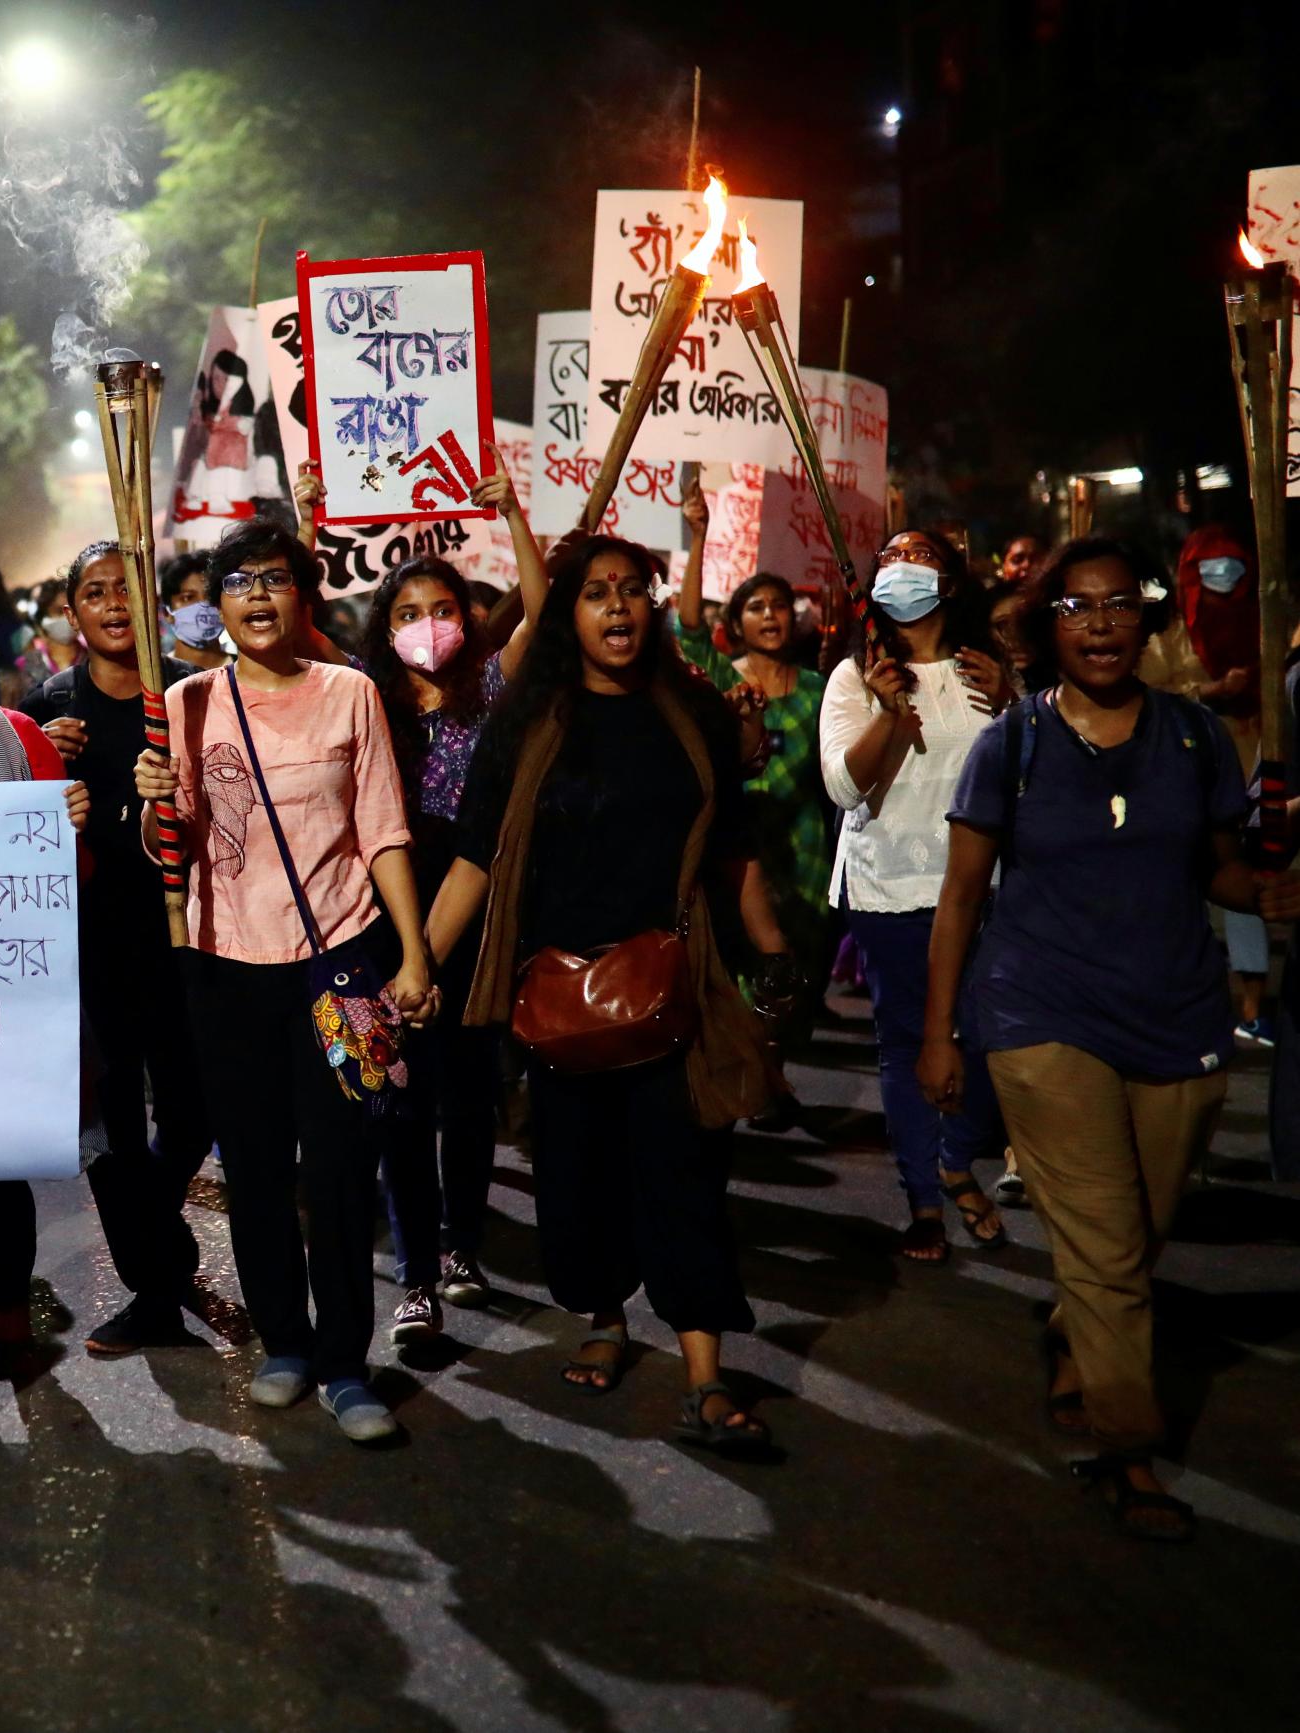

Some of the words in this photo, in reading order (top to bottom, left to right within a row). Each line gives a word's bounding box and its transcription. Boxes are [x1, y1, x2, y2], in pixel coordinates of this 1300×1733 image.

[321, 285, 403, 335] তোর
[353, 328, 473, 392] বাপের
[330, 392, 429, 462] রাস্তা
[600, 379, 679, 416] বার
[690, 370, 782, 425] অধিকার
[398, 429, 479, 511] না
[5, 811, 60, 852] নয়
